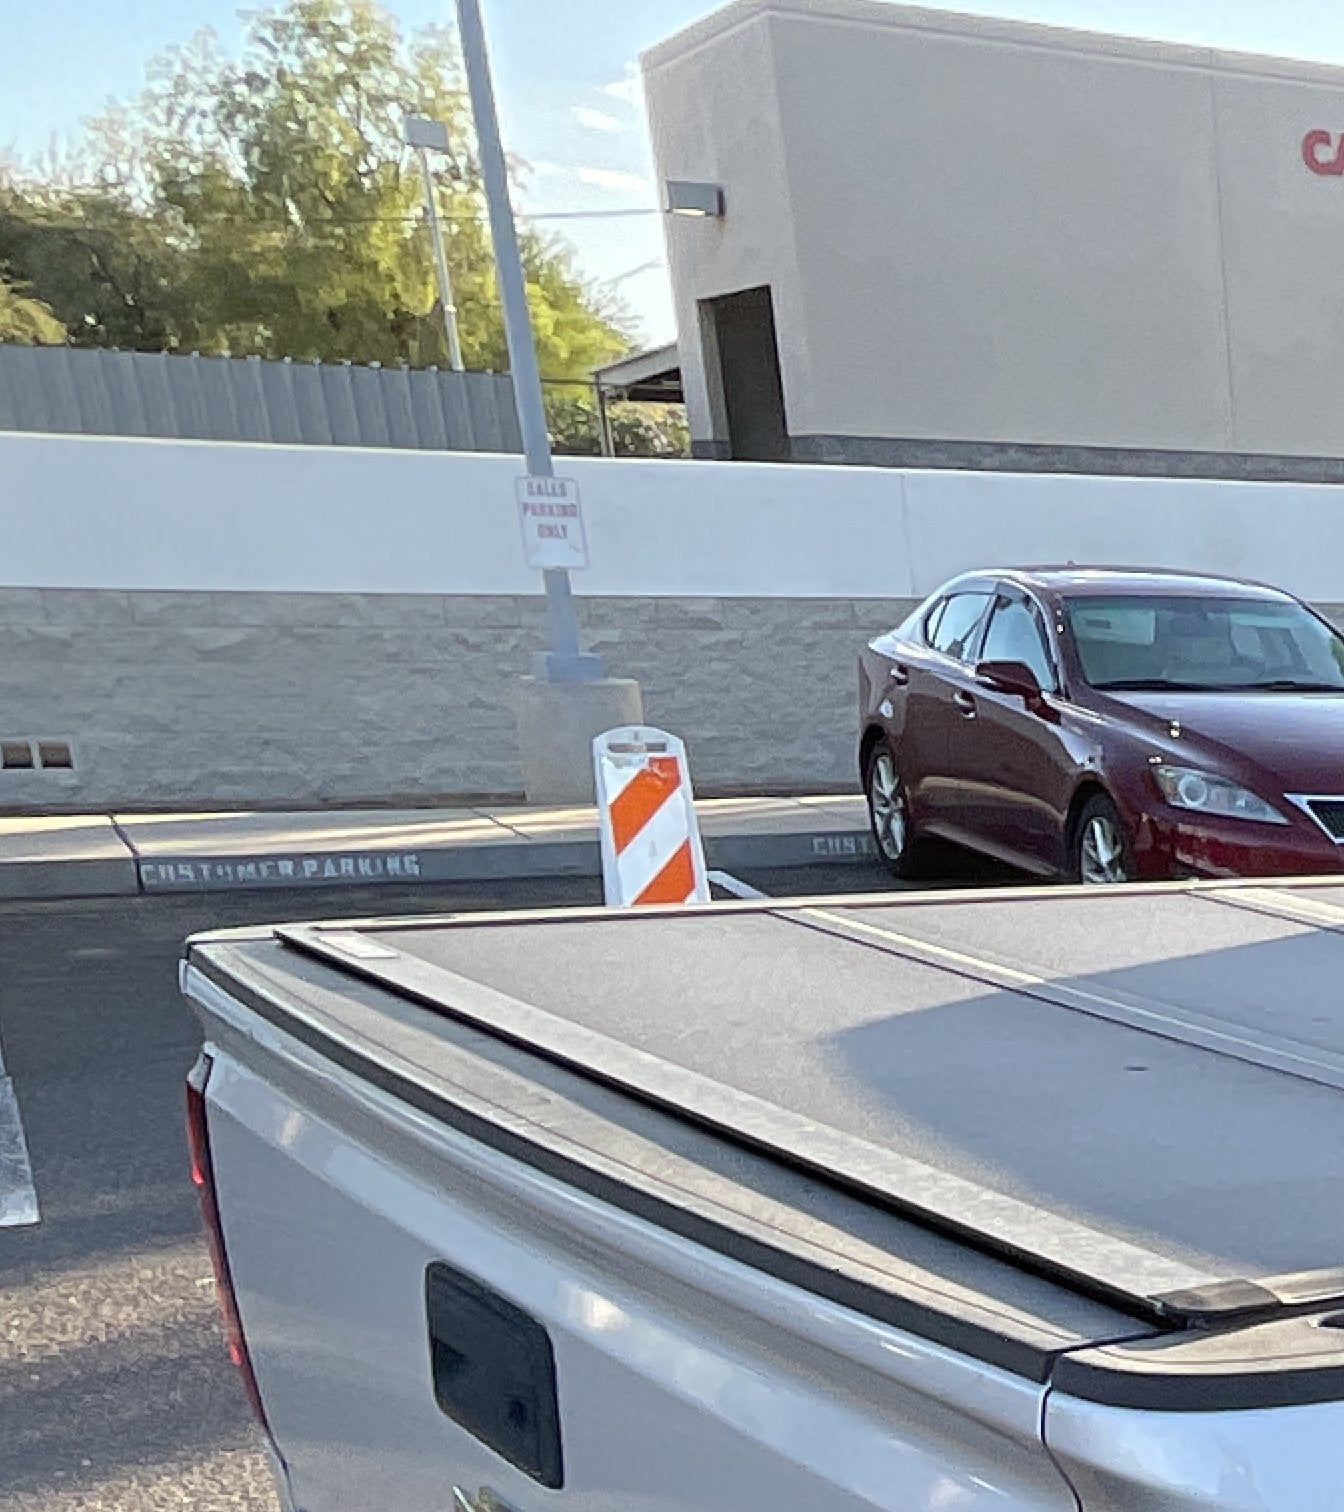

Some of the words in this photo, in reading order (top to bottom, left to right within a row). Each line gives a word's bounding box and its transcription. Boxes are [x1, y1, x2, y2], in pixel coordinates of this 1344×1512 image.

[522, 502, 578, 518] PARKING
[536, 523, 568, 539] ONLY
[140, 859, 294, 885] CUSTOMER
[302, 853, 420, 878] PARKING
